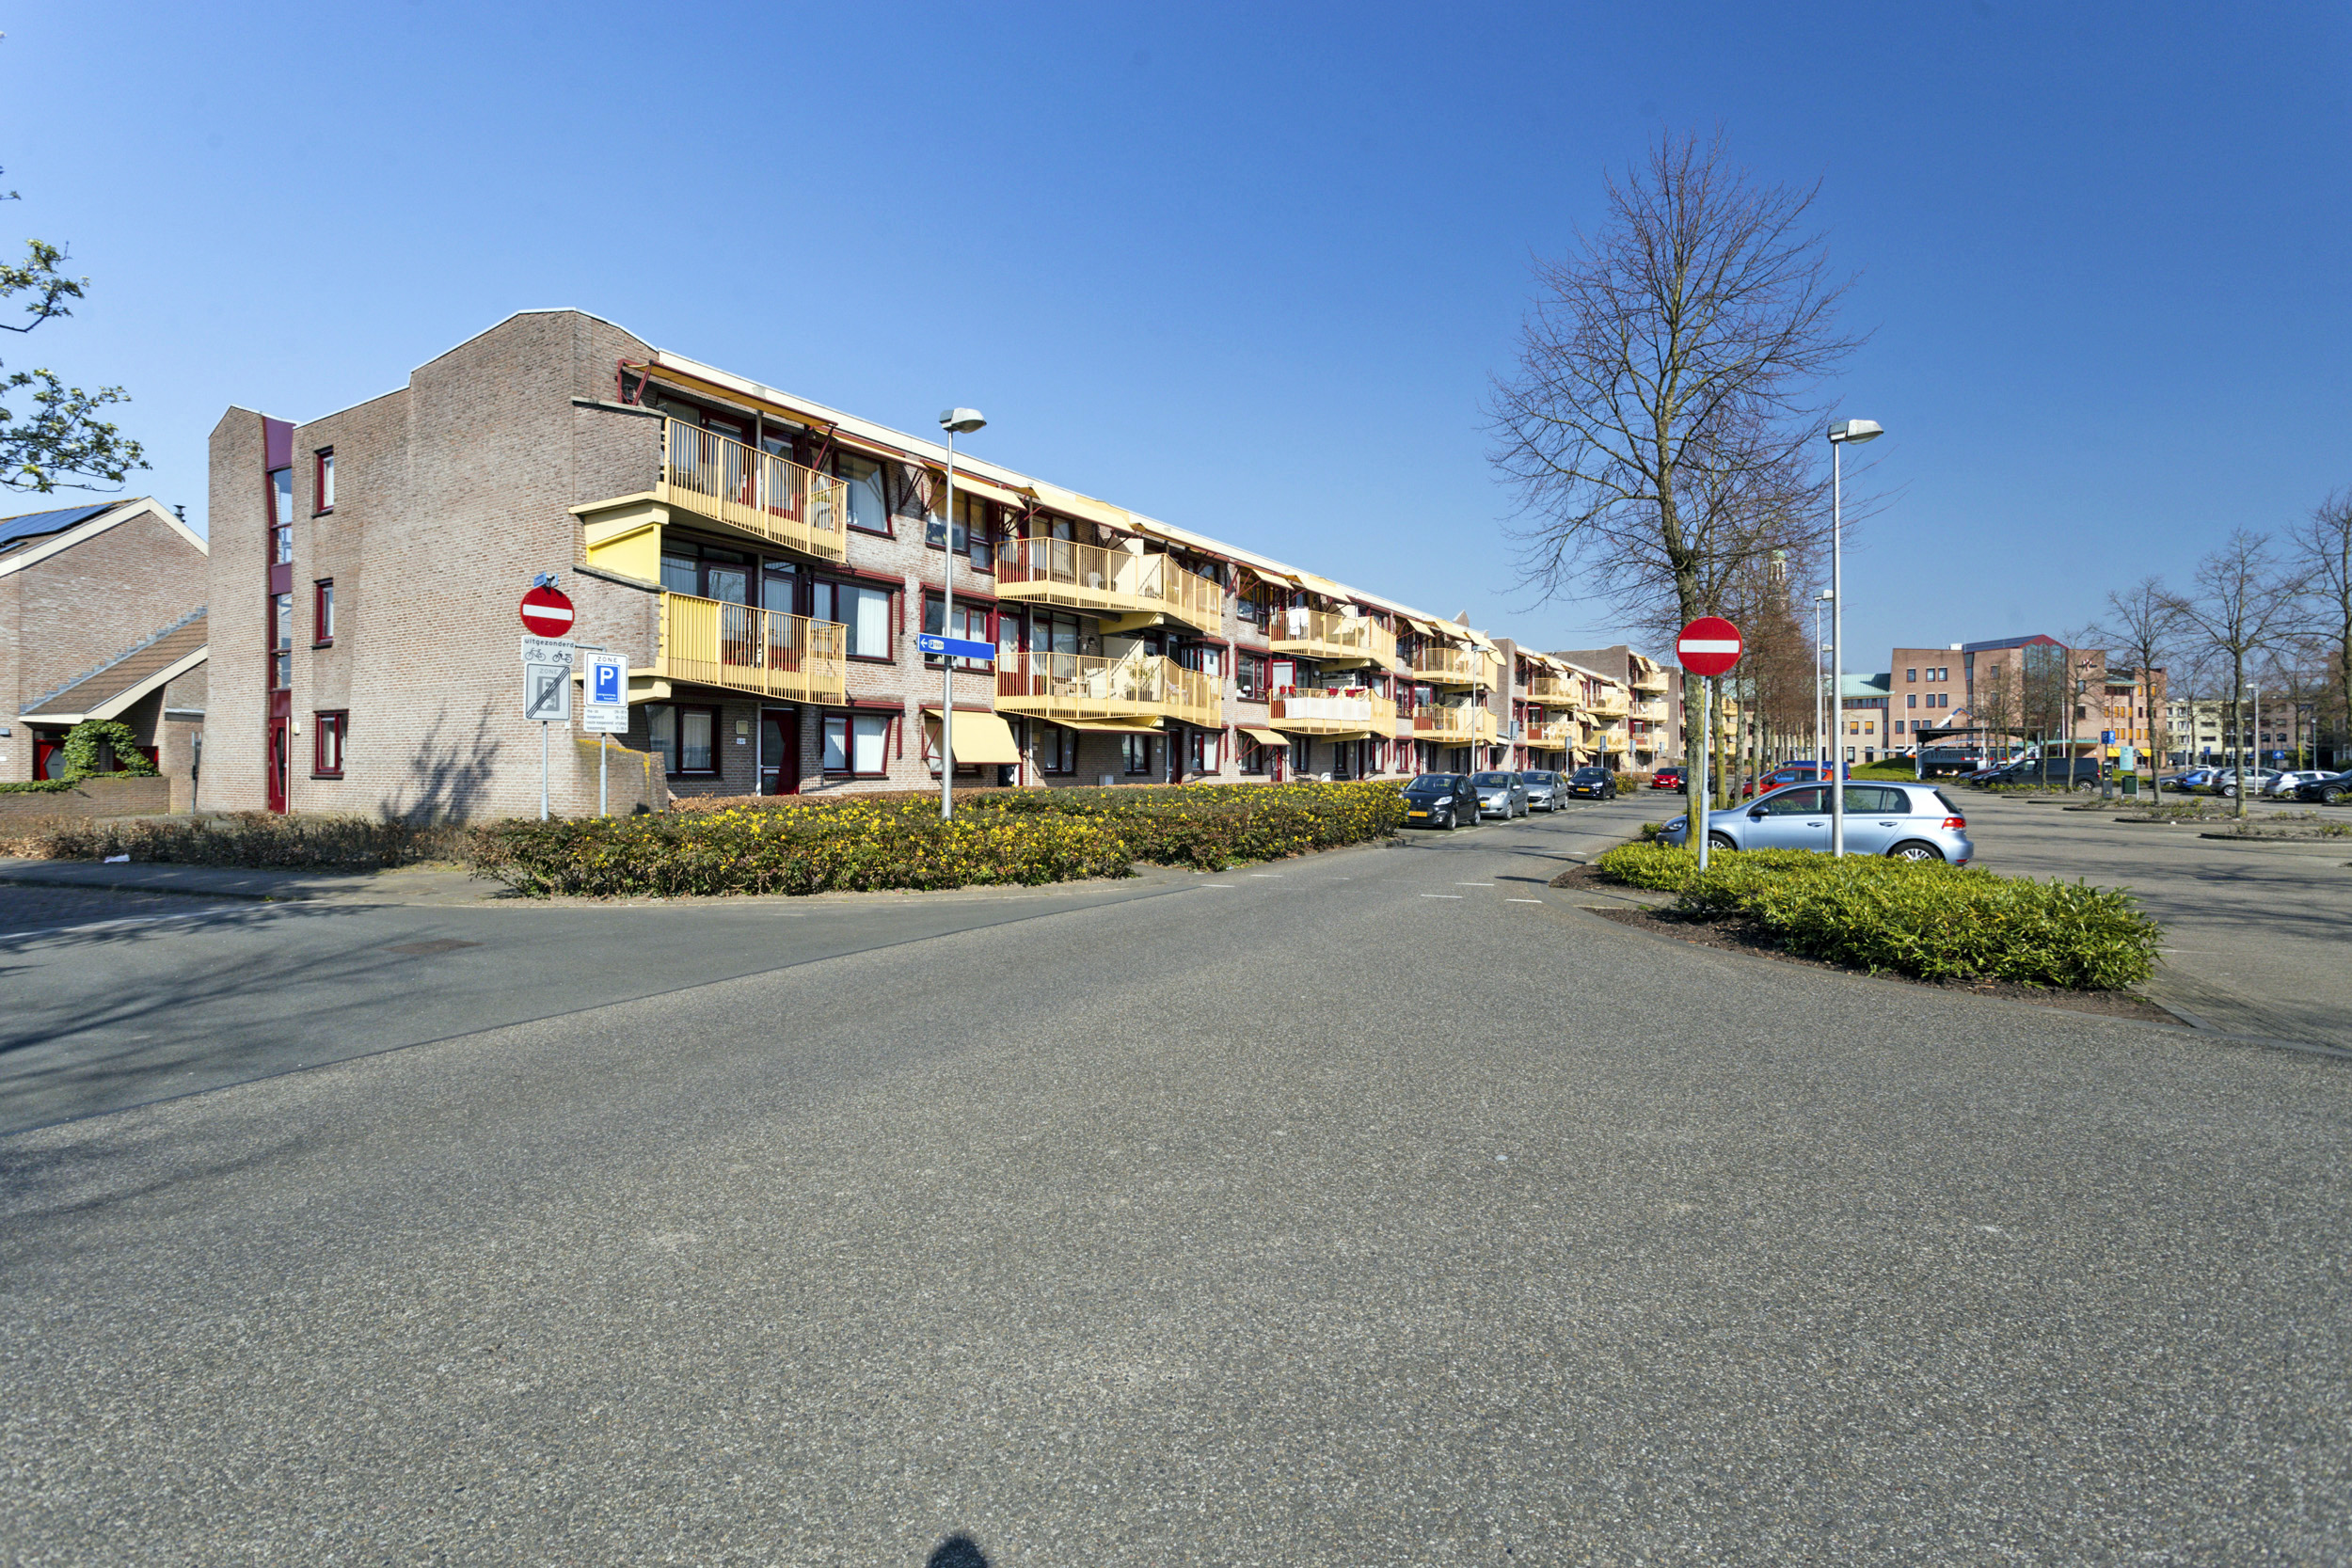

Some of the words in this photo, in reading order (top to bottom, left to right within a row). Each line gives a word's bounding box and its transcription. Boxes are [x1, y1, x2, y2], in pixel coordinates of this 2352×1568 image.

[524, 638, 575, 648] uitgezonderd
[600, 667, 614, 686] P
[1931, 751, 1965, 759] Welkom
